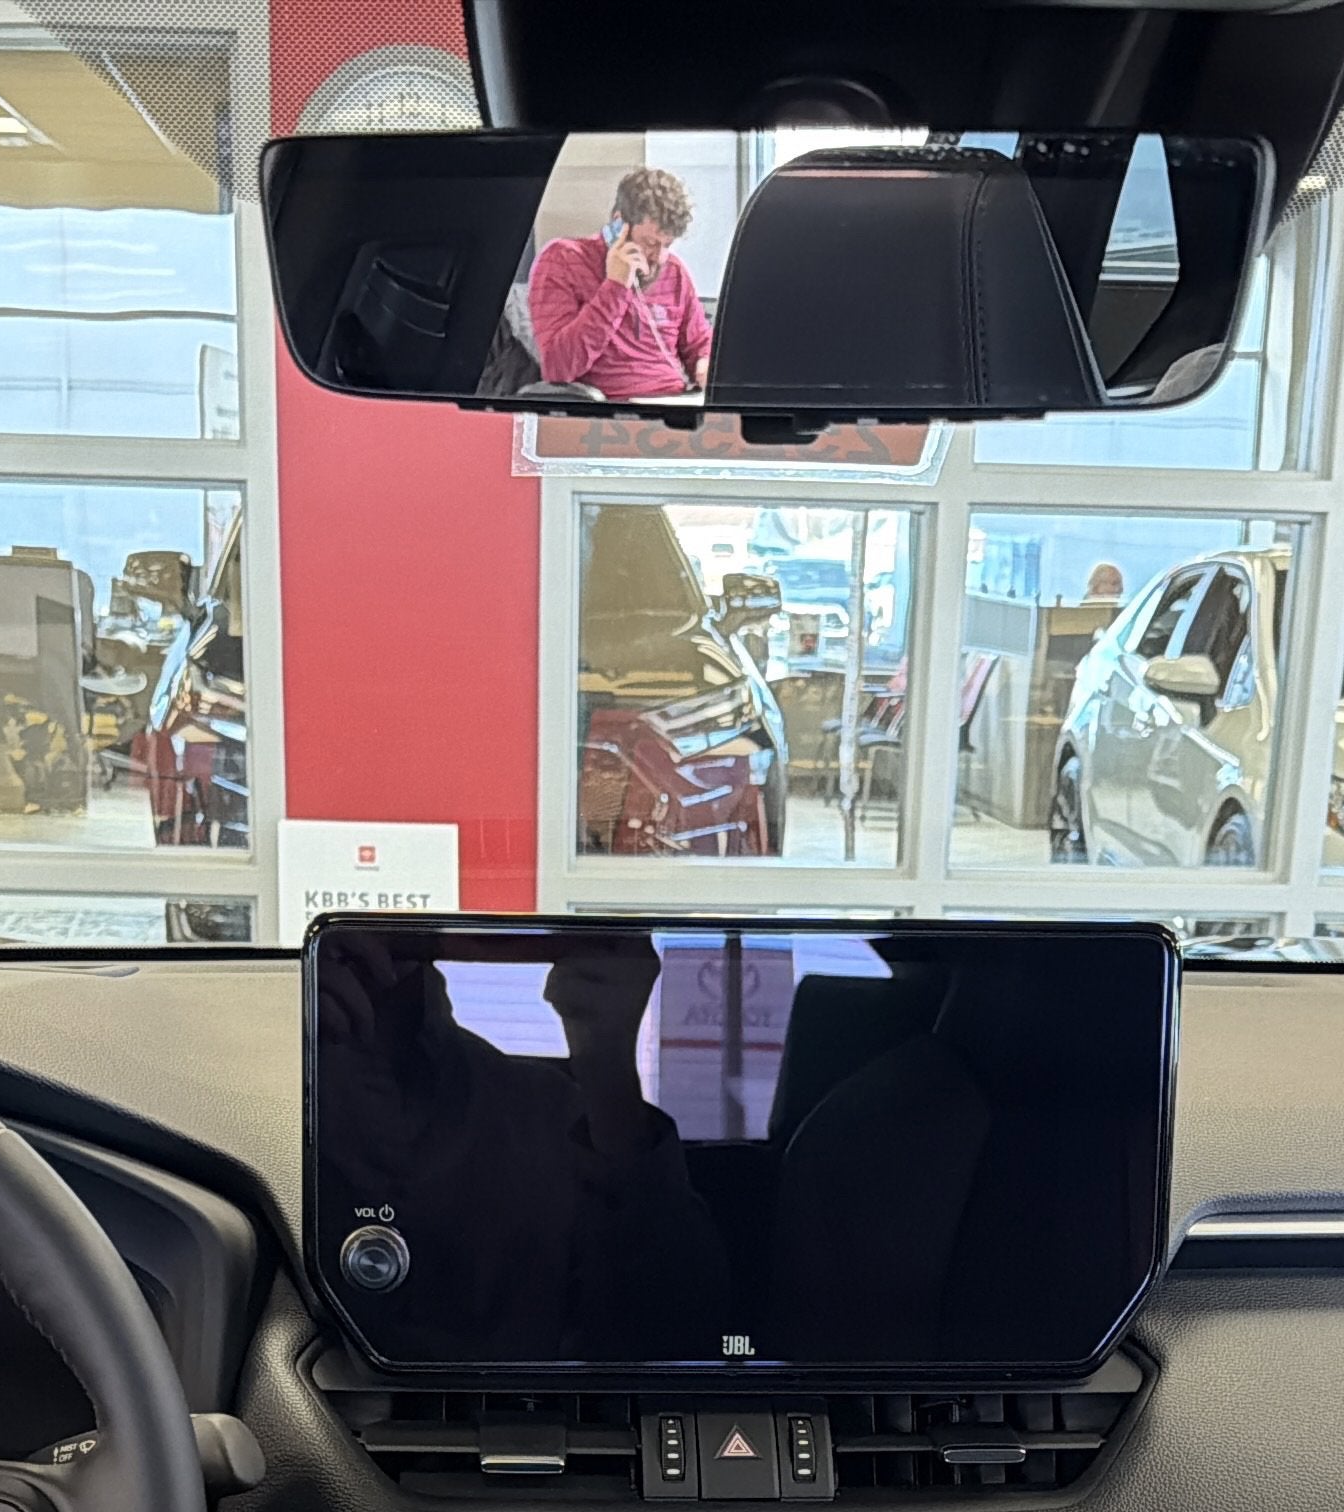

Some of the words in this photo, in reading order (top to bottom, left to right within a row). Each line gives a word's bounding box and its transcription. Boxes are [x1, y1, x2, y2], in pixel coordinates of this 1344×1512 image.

[304, 890, 369, 908] KBB'S
[377, 893, 431, 908] BEST
[354, 1207, 376, 1218] VOL
[722, 1335, 755, 1355] JBL
